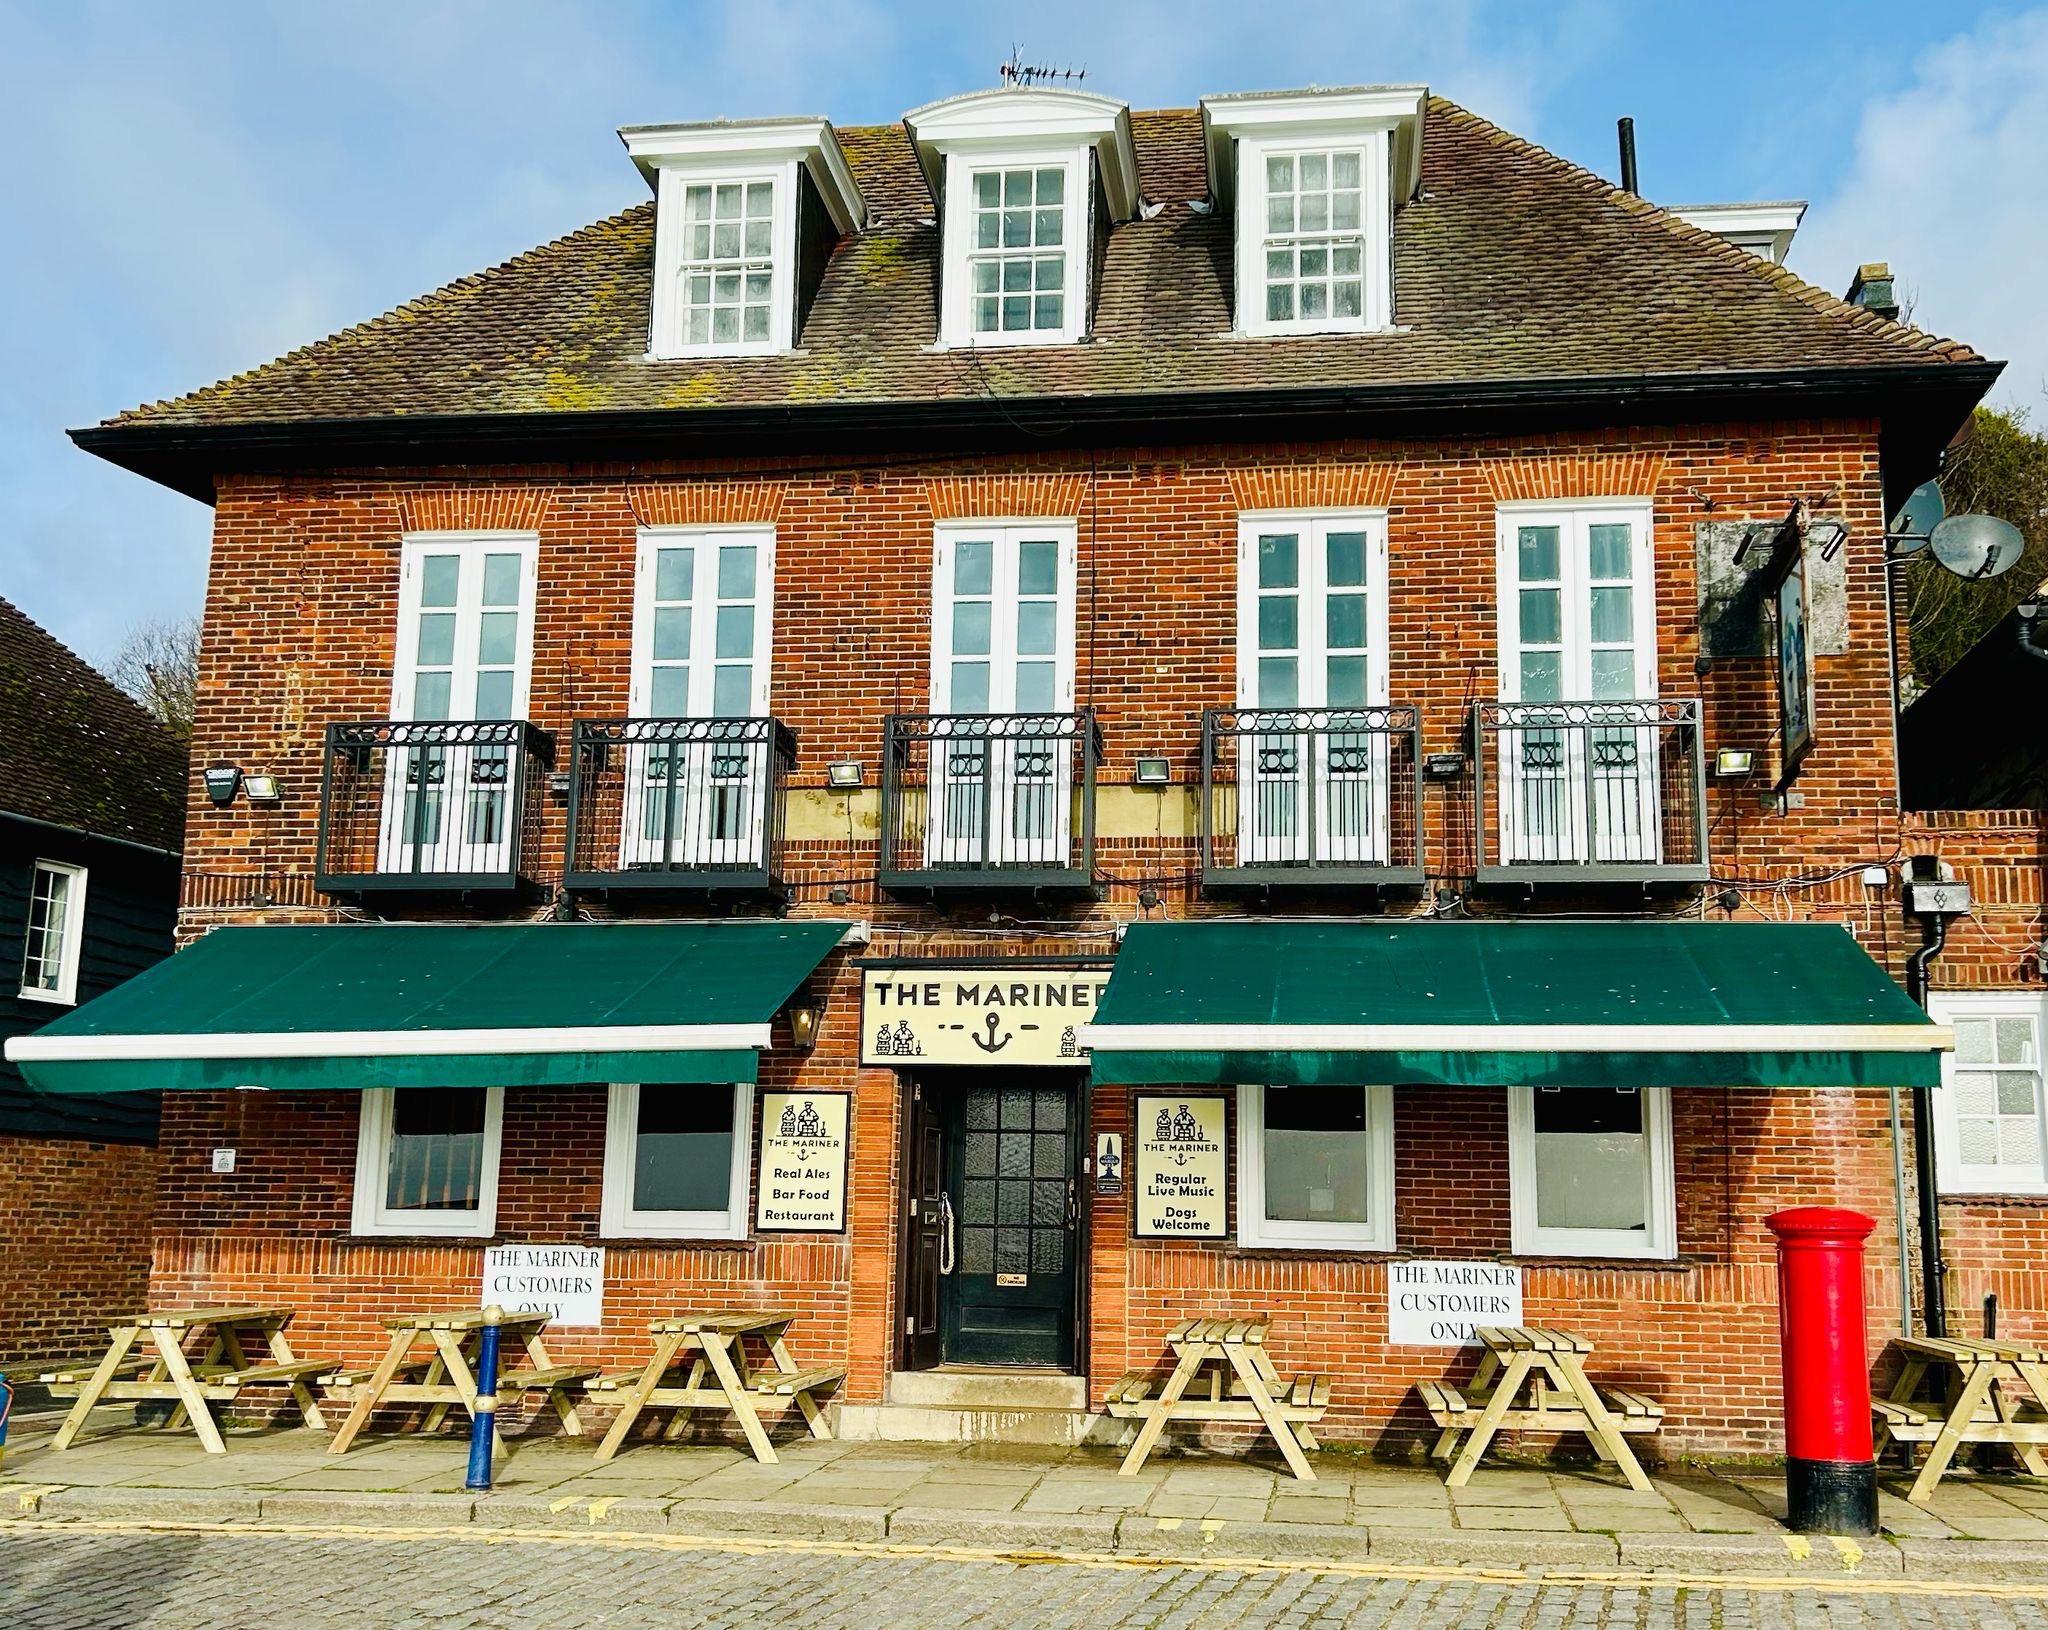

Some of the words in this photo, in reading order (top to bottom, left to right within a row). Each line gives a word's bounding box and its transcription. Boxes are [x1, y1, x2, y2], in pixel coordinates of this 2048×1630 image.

[874, 983, 941, 1006] THE
[767, 1139, 789, 1147] THE
[792, 1139, 840, 1148] MARINER
[1143, 1143, 1165, 1152] THE
[1168, 1143, 1219, 1152] MARINER
[774, 1168, 801, 1179] Real
[804, 1168, 831, 1179] Ales
[1155, 1173, 1207, 1186] Regular
[772, 1189, 795, 1199] Bar
[798, 1189, 830, 1200] Food
[1148, 1186, 1175, 1196] Live
[1178, 1186, 1214, 1197] Music
[765, 1210, 835, 1221] Restaurant
[1165, 1207, 1197, 1219] Dogs
[1152, 1219, 1211, 1231] Welcome
[490, 1250, 522, 1267] THE
[526, 1250, 600, 1268] MARINER
[1393, 1265, 1429, 1284] THE
[1434, 1267, 1517, 1286] MARINER
[494, 1275, 593, 1294] CUSTOMERS
[1400, 1293, 1511, 1314] CUSTOMERS
[1430, 1321, 1480, 1340] ONLY
